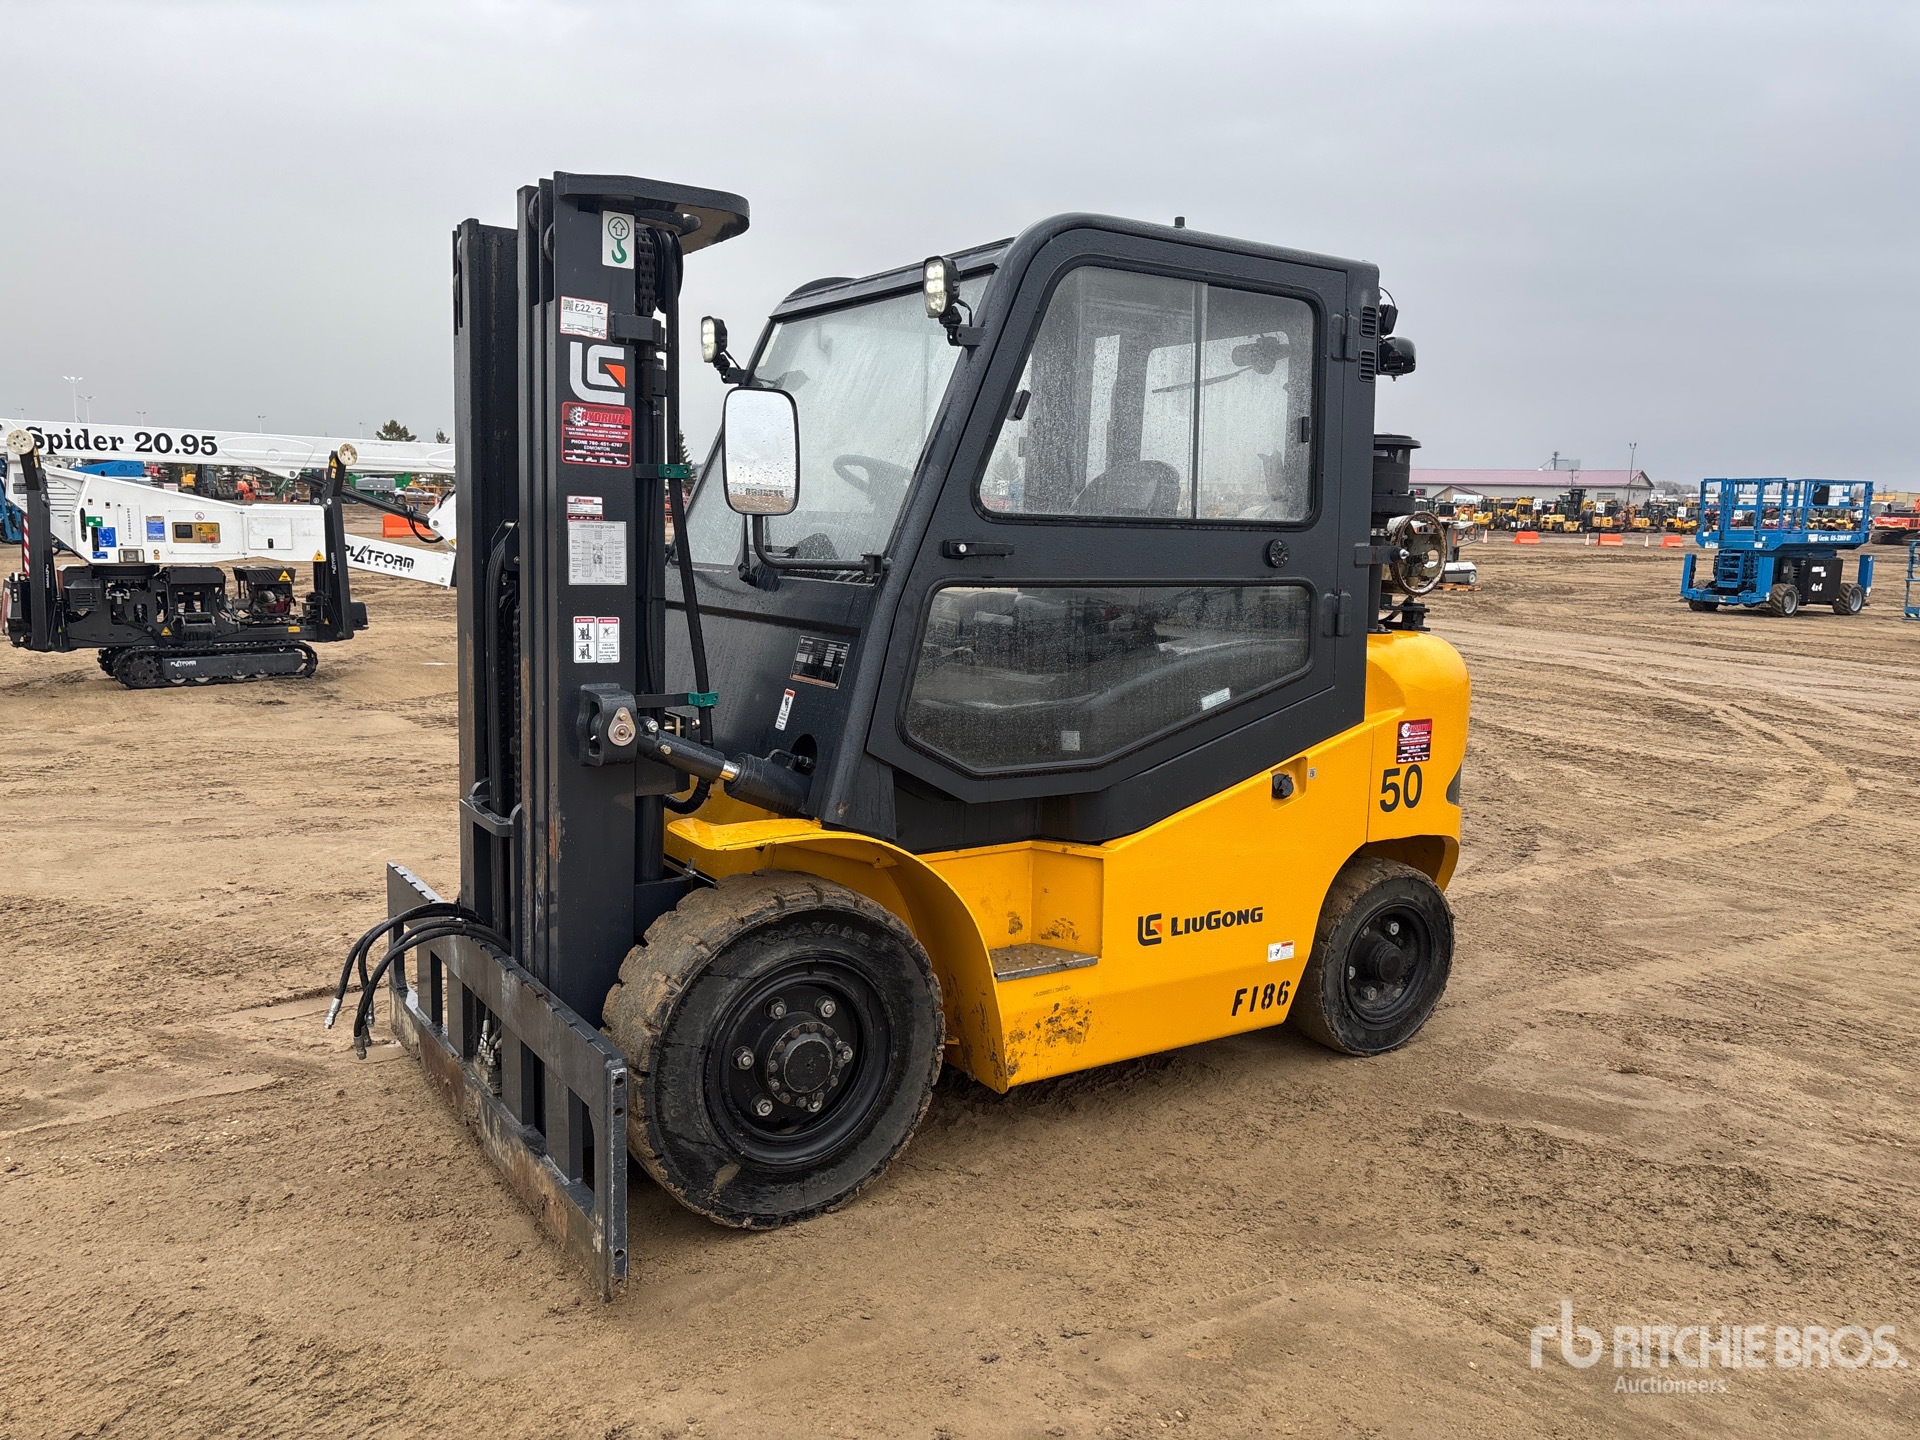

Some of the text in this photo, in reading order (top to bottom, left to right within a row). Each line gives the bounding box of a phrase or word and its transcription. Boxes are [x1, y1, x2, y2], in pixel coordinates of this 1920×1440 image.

[25, 426, 218, 456] Spider 20.95
[1379, 763, 1423, 813] 50
[1231, 980, 1291, 1017] F186
